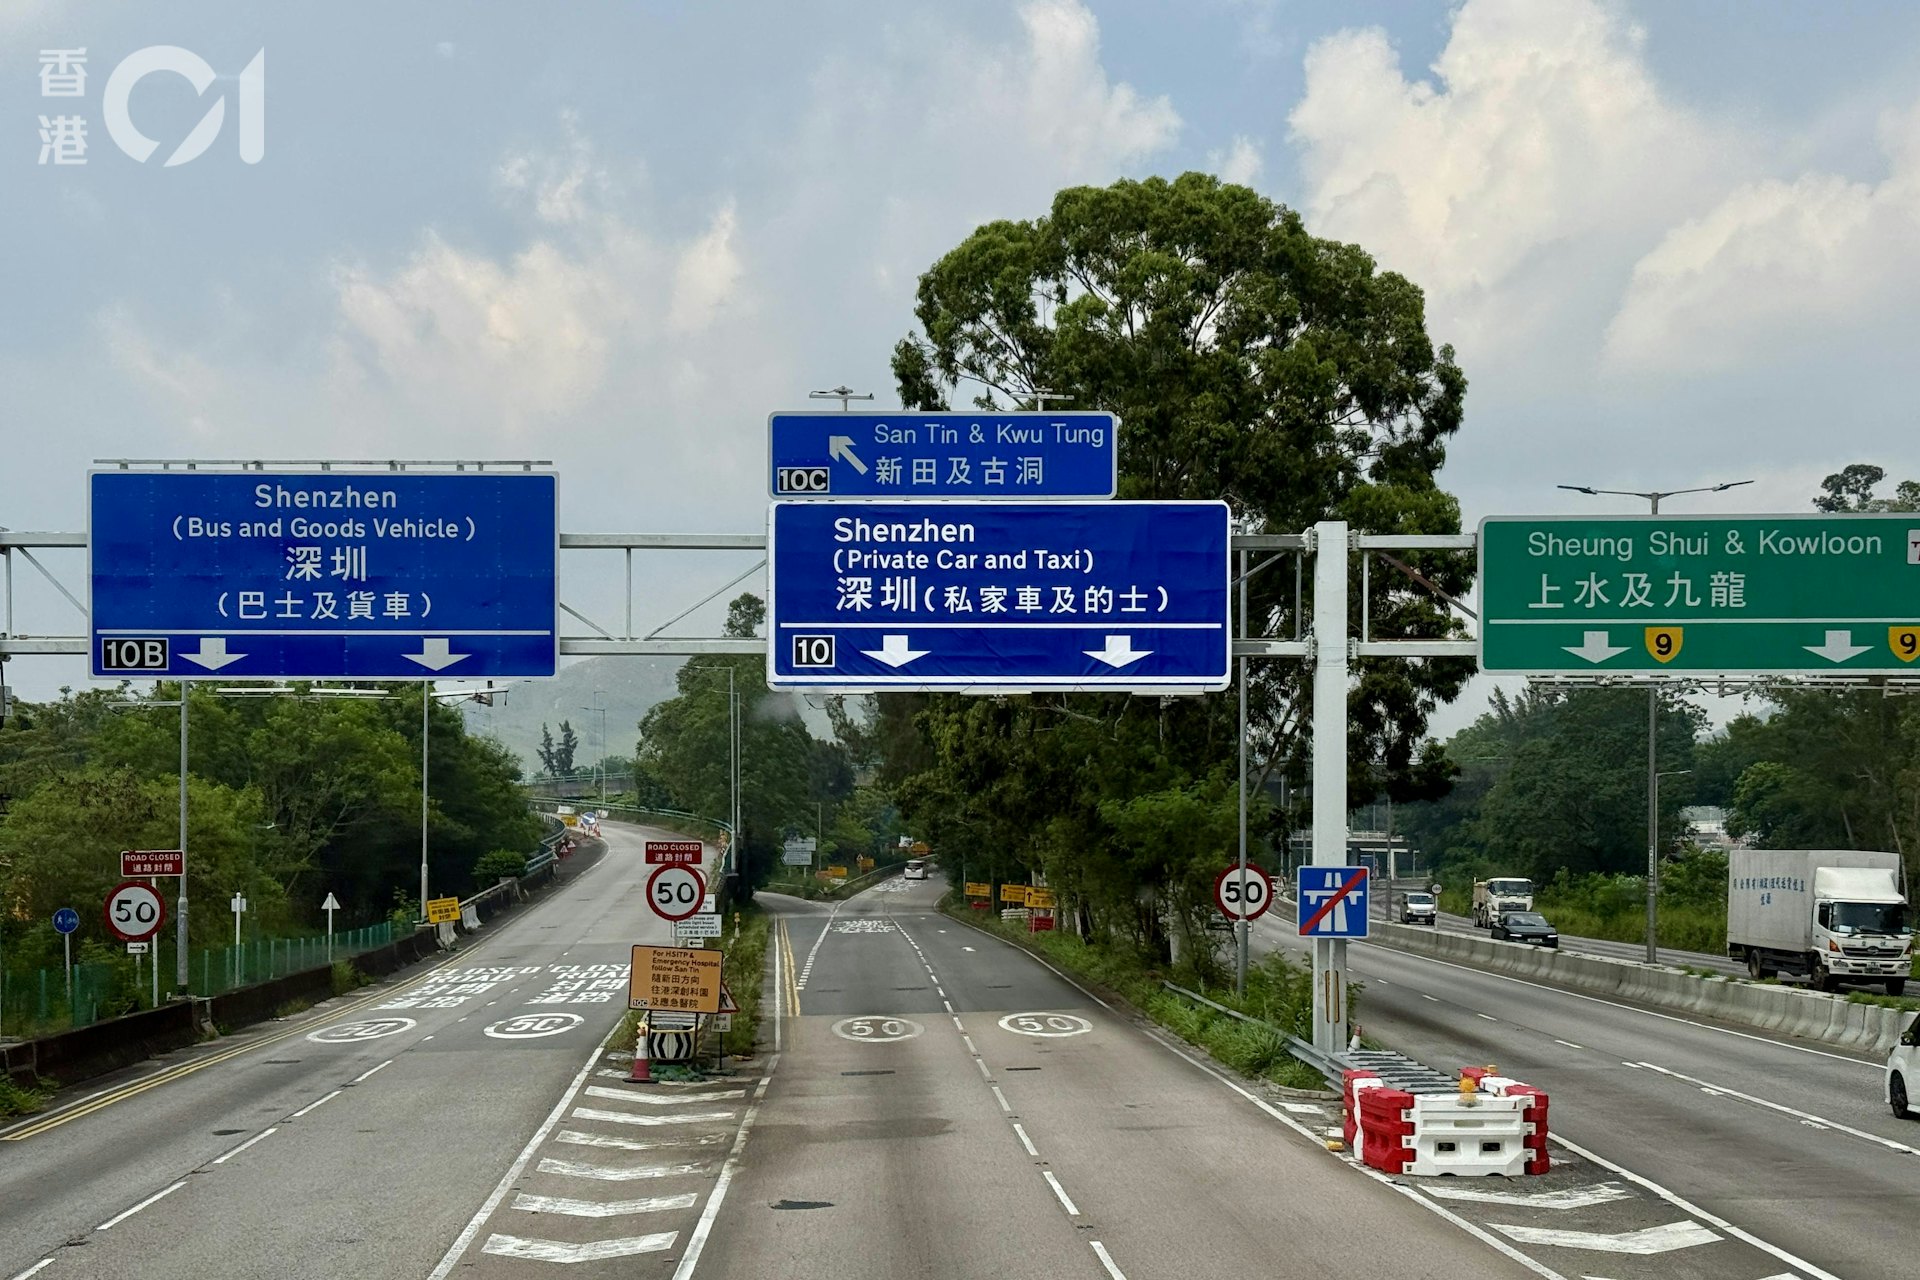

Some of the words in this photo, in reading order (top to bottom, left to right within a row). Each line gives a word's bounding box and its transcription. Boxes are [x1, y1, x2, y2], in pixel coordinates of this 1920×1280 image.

[875, 424, 916, 443] San
[925, 424, 957, 443] Tin
[969, 424, 985, 443] &
[998, 424, 1042, 443] Kwu
[1051, 423, 1103, 447] Tung
[778, 469, 828, 491] 10C
[875, 455, 1043, 486] 新田及古洞
[254, 483, 397, 508] Shenzhen
[172, 515, 232, 541] (Bus
[239, 518, 282, 538] and
[290, 518, 366, 538] Goods
[373, 518, 459, 538] Vehicle
[833, 517, 975, 542] Shenzhen
[1527, 532, 1633, 562] Sheung
[1649, 531, 1709, 556] Shui
[1724, 530, 1746, 555] &
[1759, 530, 1882, 555] Kowloon
[285, 545, 367, 582] 深圳
[833, 549, 929, 573] (Private
[936, 550, 978, 570] Car
[984, 550, 1027, 570] and
[1033, 549, 1094, 573] Taxi)
[1527, 571, 1747, 609] 上水及九龍
[218, 591, 432, 620] (巴士及貨車)
[105, 641, 165, 669] 10B
[797, 638, 831, 664] 10
[1655, 633, 1672, 656] 9
[1899, 632, 1917, 655] 9
[124, 854, 148, 862] ROAD
[149, 853, 181, 861] CLOSED
[655, 853, 693, 862] 道路封閉
[670, 843, 700, 851] CLOSED
[133, 863, 173, 873] 道路封閉
[657, 882, 696, 905] 50
[1225, 881, 1263, 904] 50
[115, 899, 156, 923] 50
[427, 966, 542, 976] CLOSED
[652, 957, 690, 966] Emergency
[691, 960, 720, 968] Hospital
[425, 975, 516, 984] ROAD
[651, 973, 700, 984] 隨新田方向
[650, 997, 699, 1009] 及應急醫院
[851, 1021, 904, 1036] 50
[1017, 1016, 1074, 1031] 50
